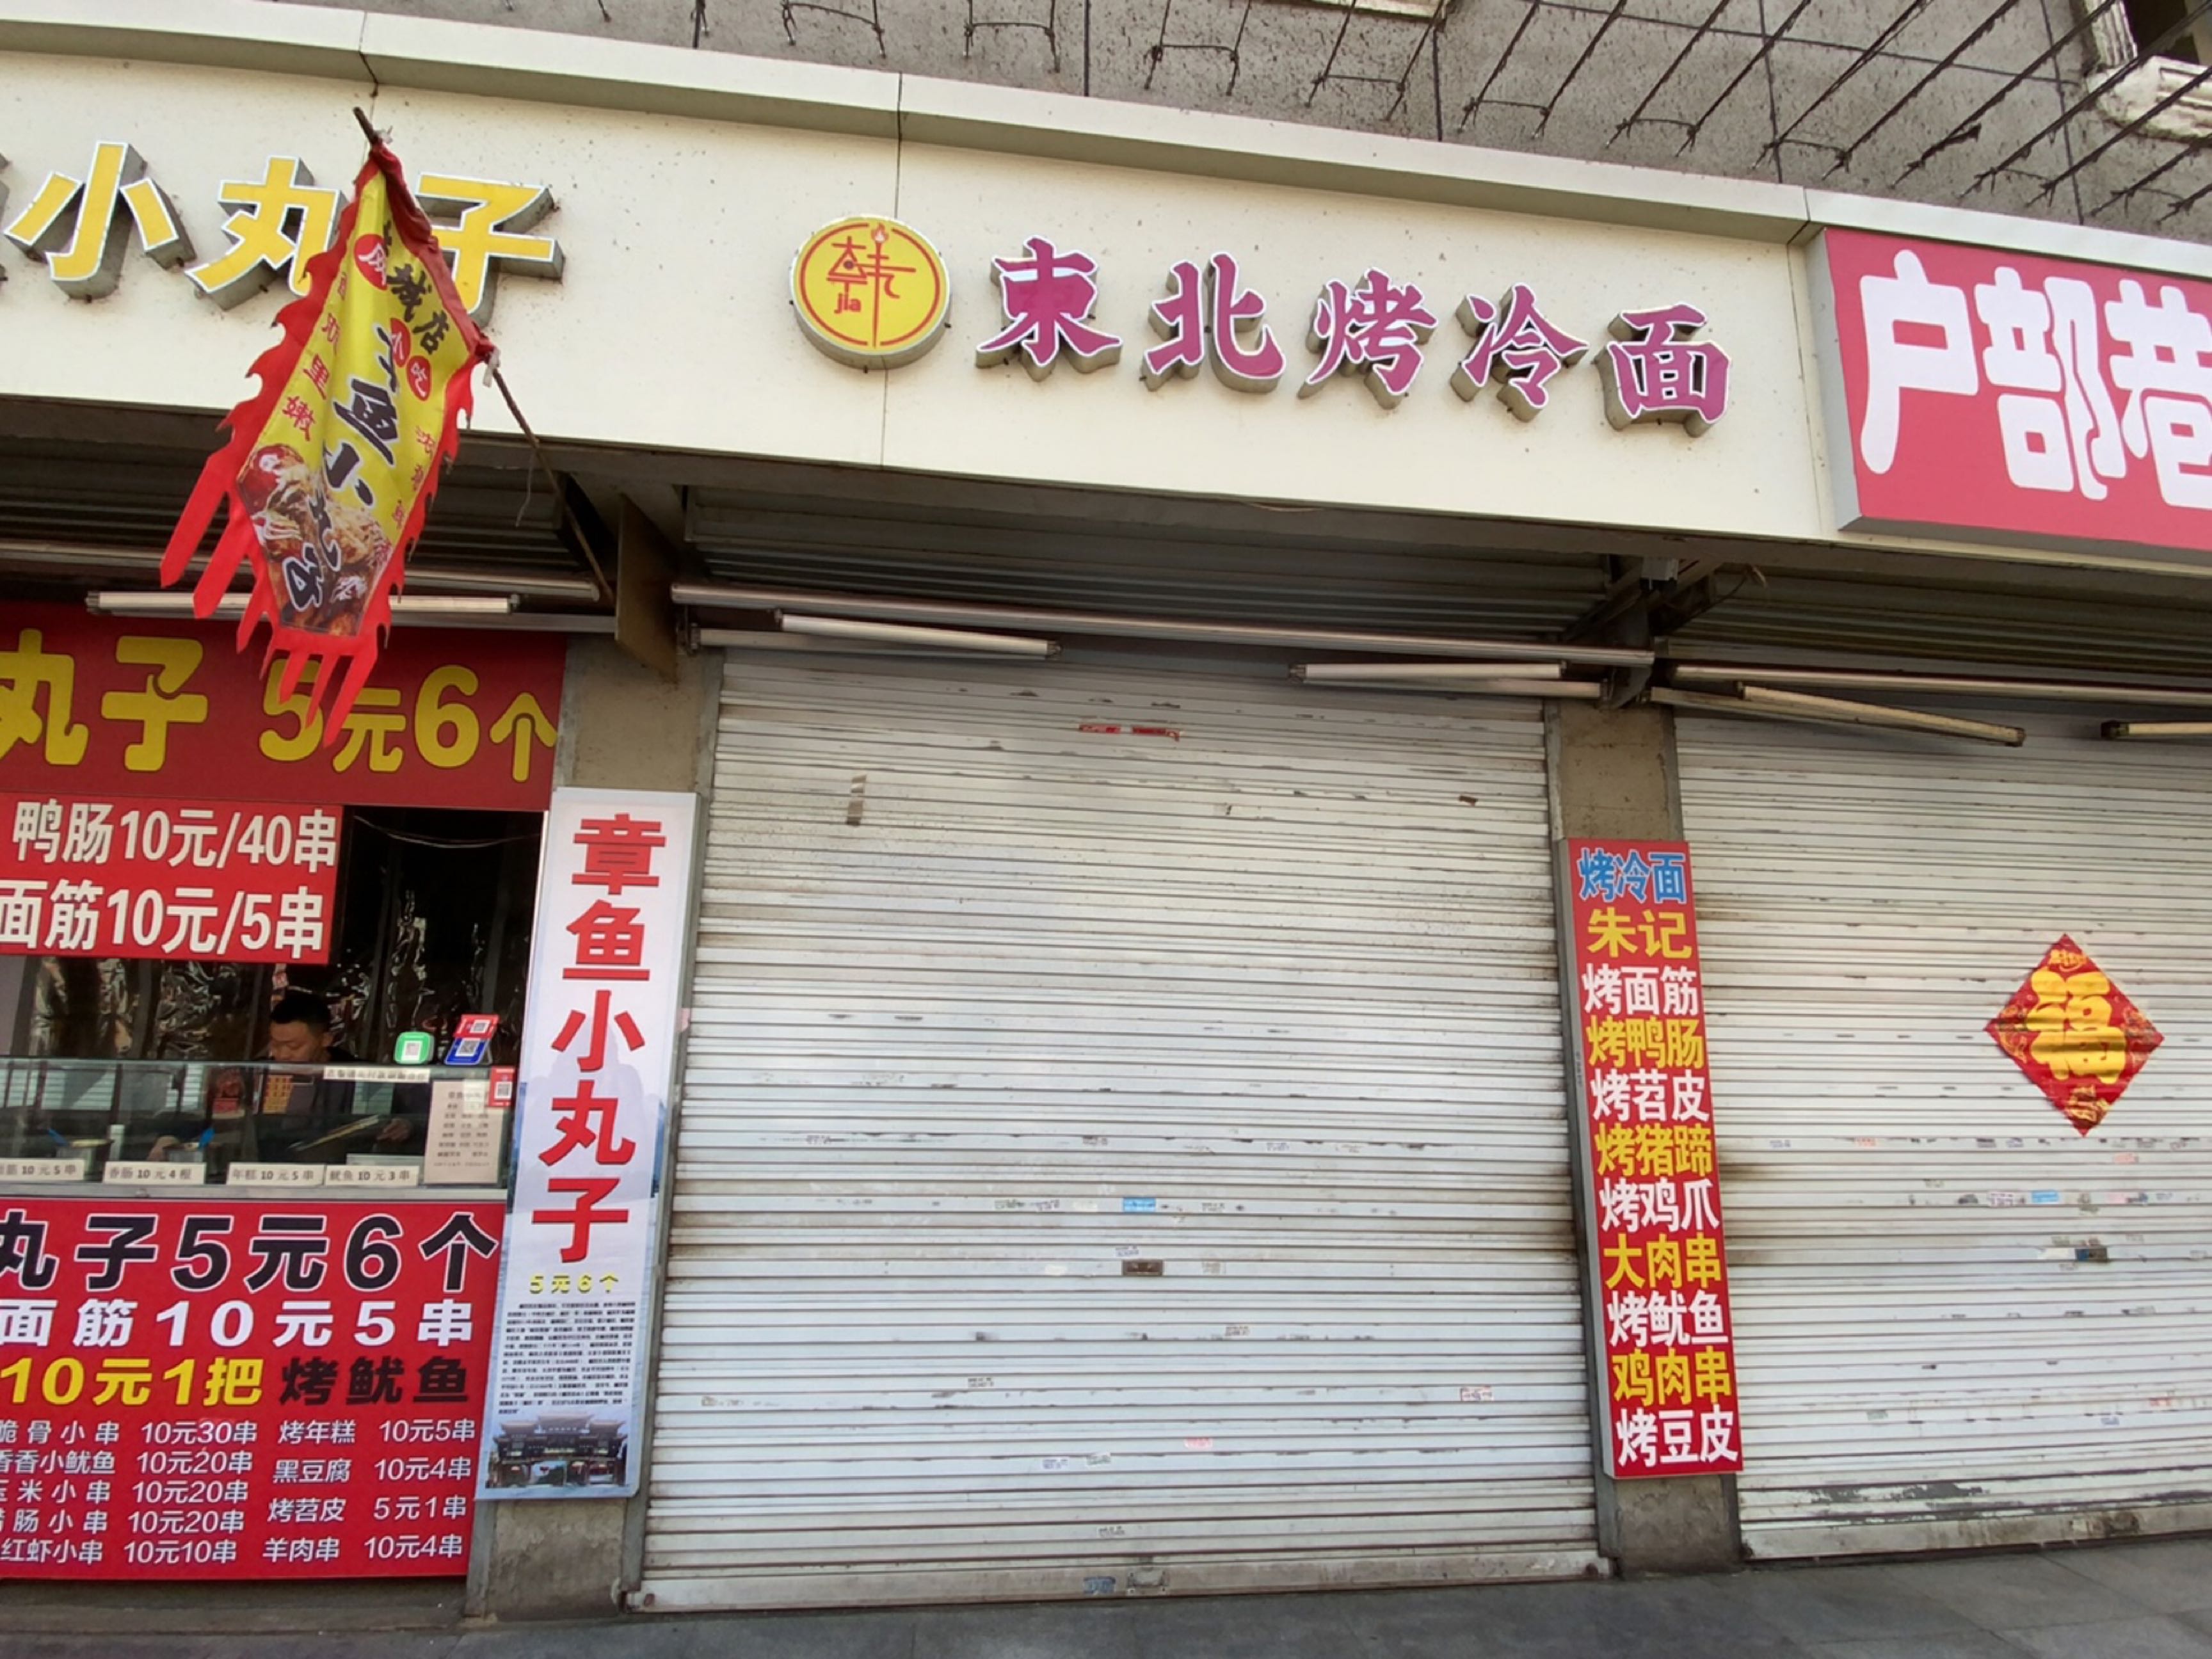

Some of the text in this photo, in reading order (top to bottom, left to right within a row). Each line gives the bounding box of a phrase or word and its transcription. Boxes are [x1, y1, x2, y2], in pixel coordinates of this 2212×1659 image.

[3, 141, 554, 315] 小丸子
[1860, 250, 2212, 510] 户部巷
[0, 629, 208, 771] 丸子
[13, 798, 337, 873] 鸭肠10元/40串
[1577, 847, 1687, 904] 烤冷面
[0, 879, 325, 959] 面筋10元/5串
[1587, 906, 1693, 959] 朱记
[1582, 963, 1698, 1016] 烤面筋
[531, 813, 667, 1263] 章鱼小丸子
[1587, 1014, 1704, 1070] 烤鸭肠
[1591, 1068, 1710, 1122] 烤苕皮
[1594, 1122, 1713, 1177] 烤猪蹄
[1599, 1176, 1720, 1233] 烤鸡爪
[529, 1274, 619, 1295] 5元6个
[1603, 1231, 1722, 1289] 大肉串
[1607, 1289, 1729, 1347] 烤鱿鱼
[0, 1357, 264, 1407] 10元1把
[279, 1355, 469, 1406] 烤鱿鱼
[1611, 1345, 1732, 1407] 鸡肉串
[140, 1420, 258, 1445] 10元30串
[277, 1419, 357, 1445] 烤年糕
[379, 1418, 476, 1443] 10元5串
[1616, 1404, 1739, 1468] 烤豆皮
[136, 1450, 253, 1475] 10元20串
[273, 1457, 353, 1484] 黑豆腐
[374, 1456, 472, 1480] 10元4串
[132, 1479, 249, 1504] 10元20串
[267, 1496, 347, 1523] 烤苕皮
[373, 1495, 467, 1519] 5元1串
[0, 1509, 463, 1562] 肠小串 10元20串 羊肉串 10元4串
[0, 1538, 237, 1566] 红虾小串 10元10串
